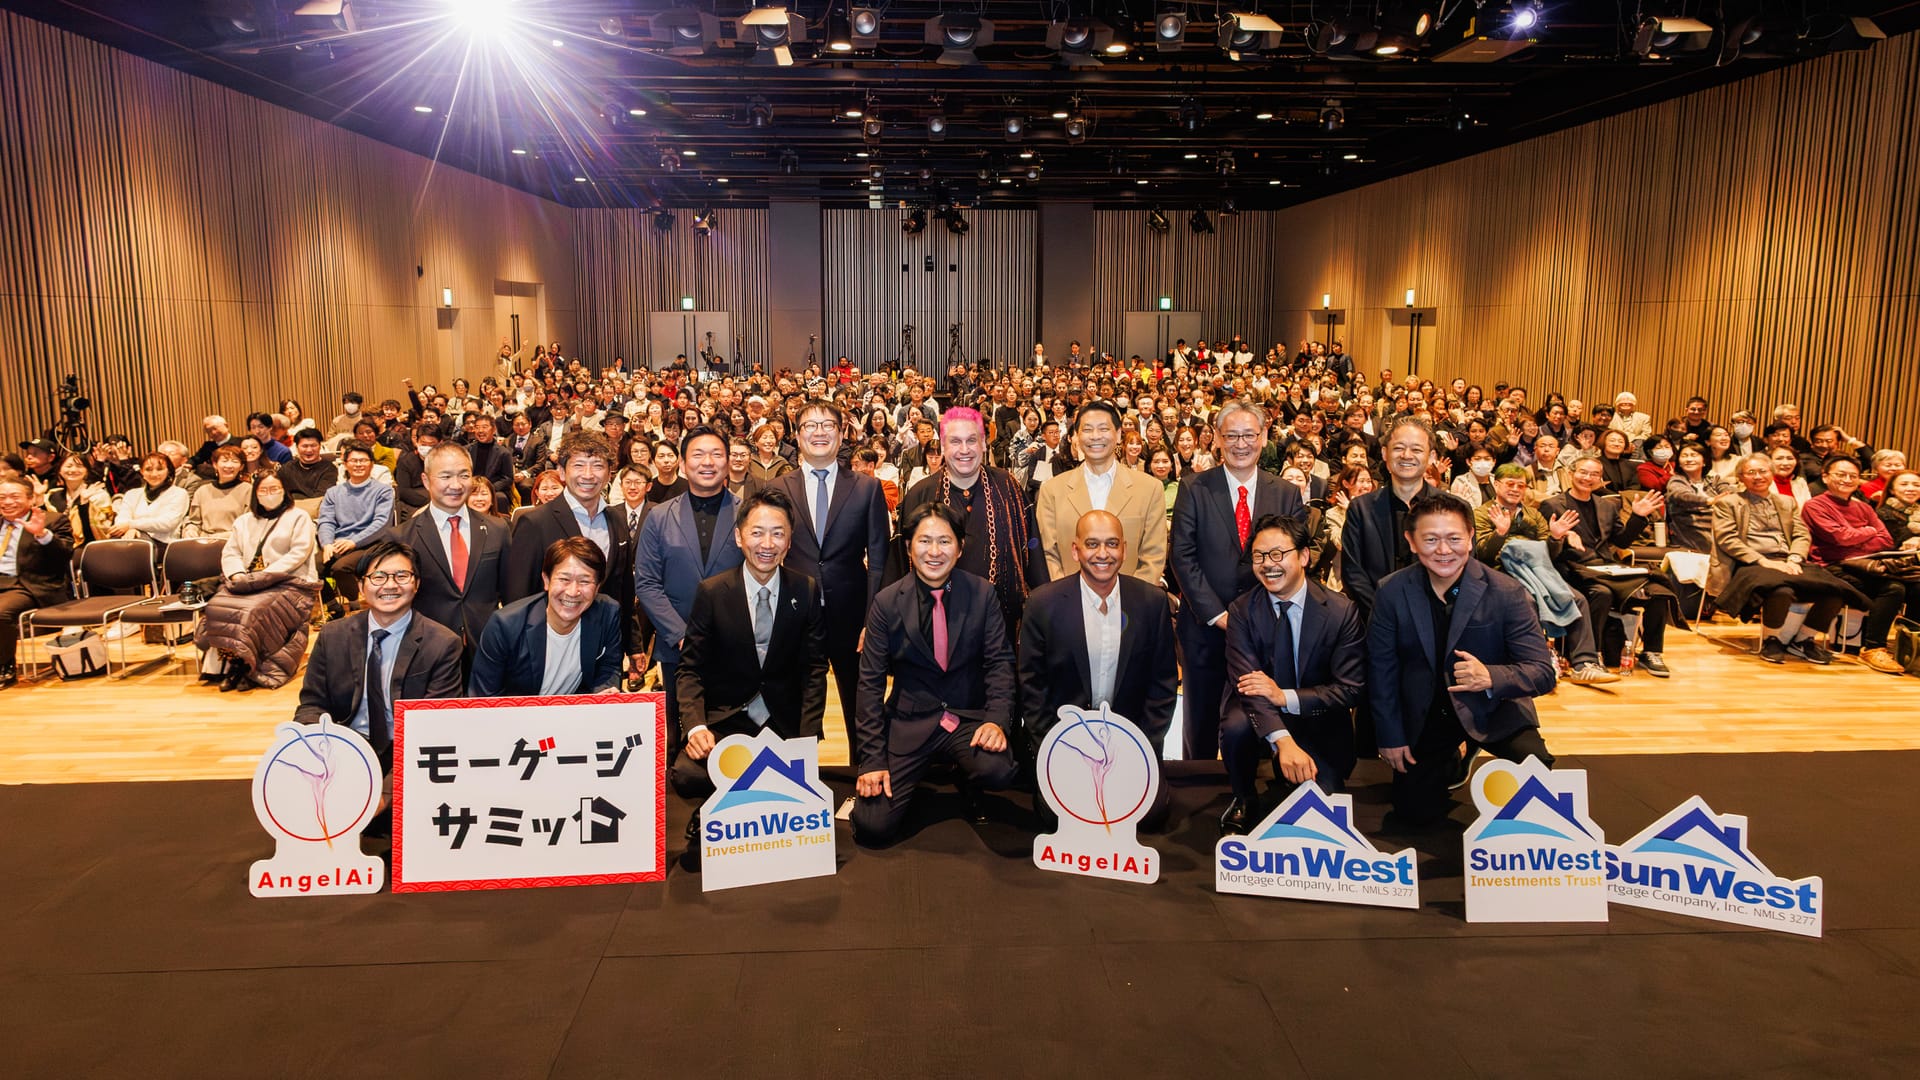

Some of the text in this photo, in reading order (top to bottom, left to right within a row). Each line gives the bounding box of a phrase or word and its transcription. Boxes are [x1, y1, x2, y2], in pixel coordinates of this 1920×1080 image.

[416, 733, 643, 784] モーゲージ
[705, 832, 831, 857] Investments Trust
[1040, 845, 1150, 876] AngelAi
[257, 867, 374, 892] AngelAi
[1220, 871, 1414, 897] Mortgage Company, Inc. NMLS 3277
[1471, 874, 1603, 887] Investments Trust
[1607, 882, 1817, 926] rtgage Company, Inc. NMLS 3277
